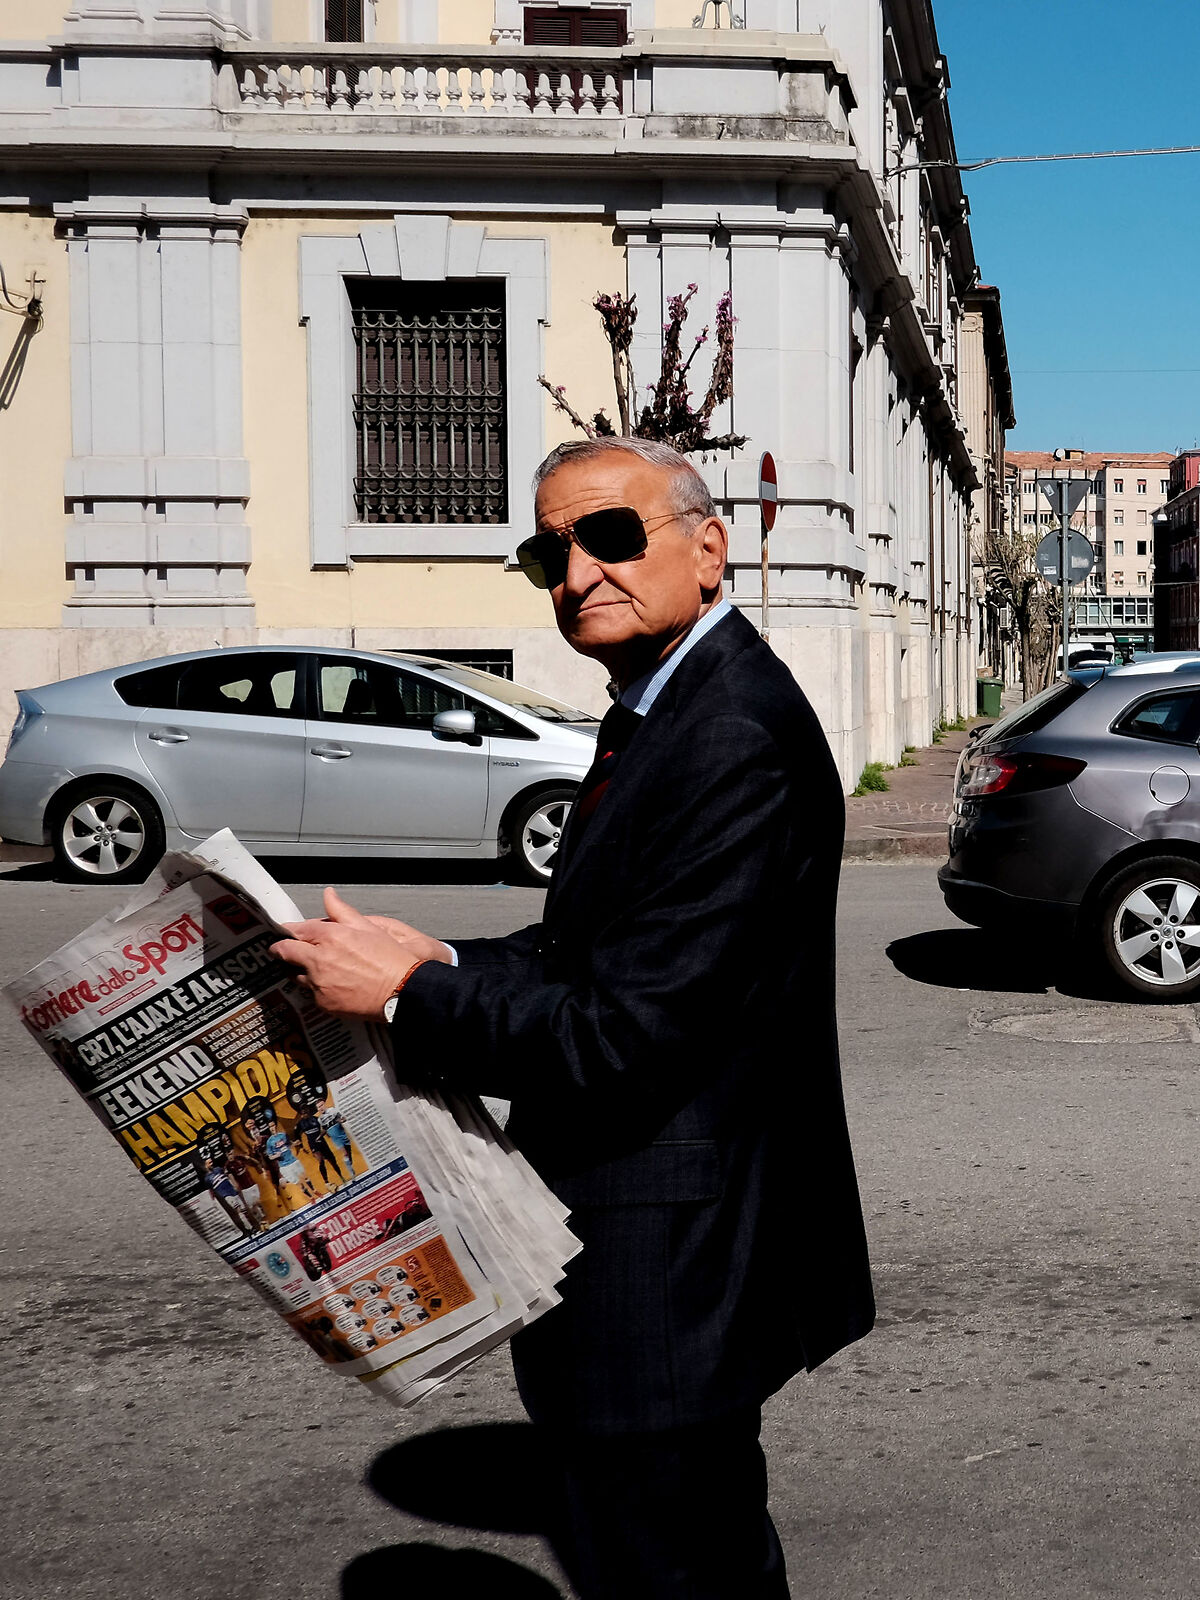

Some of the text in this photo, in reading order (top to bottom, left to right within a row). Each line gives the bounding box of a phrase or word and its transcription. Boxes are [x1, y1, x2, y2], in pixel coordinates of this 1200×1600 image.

[19, 977, 101, 1035] Corriere
[93, 963, 137, 997] dello
[120, 911, 208, 976] Sport
[199, 933, 278, 996] RISCH
[187, 978, 213, 1004] A
[111, 998, 180, 1048] L'AJAX
[76, 1031, 124, 1068] CR7,
[328, 1237, 347, 1258] DI
[341, 1217, 383, 1251] ROSSE
